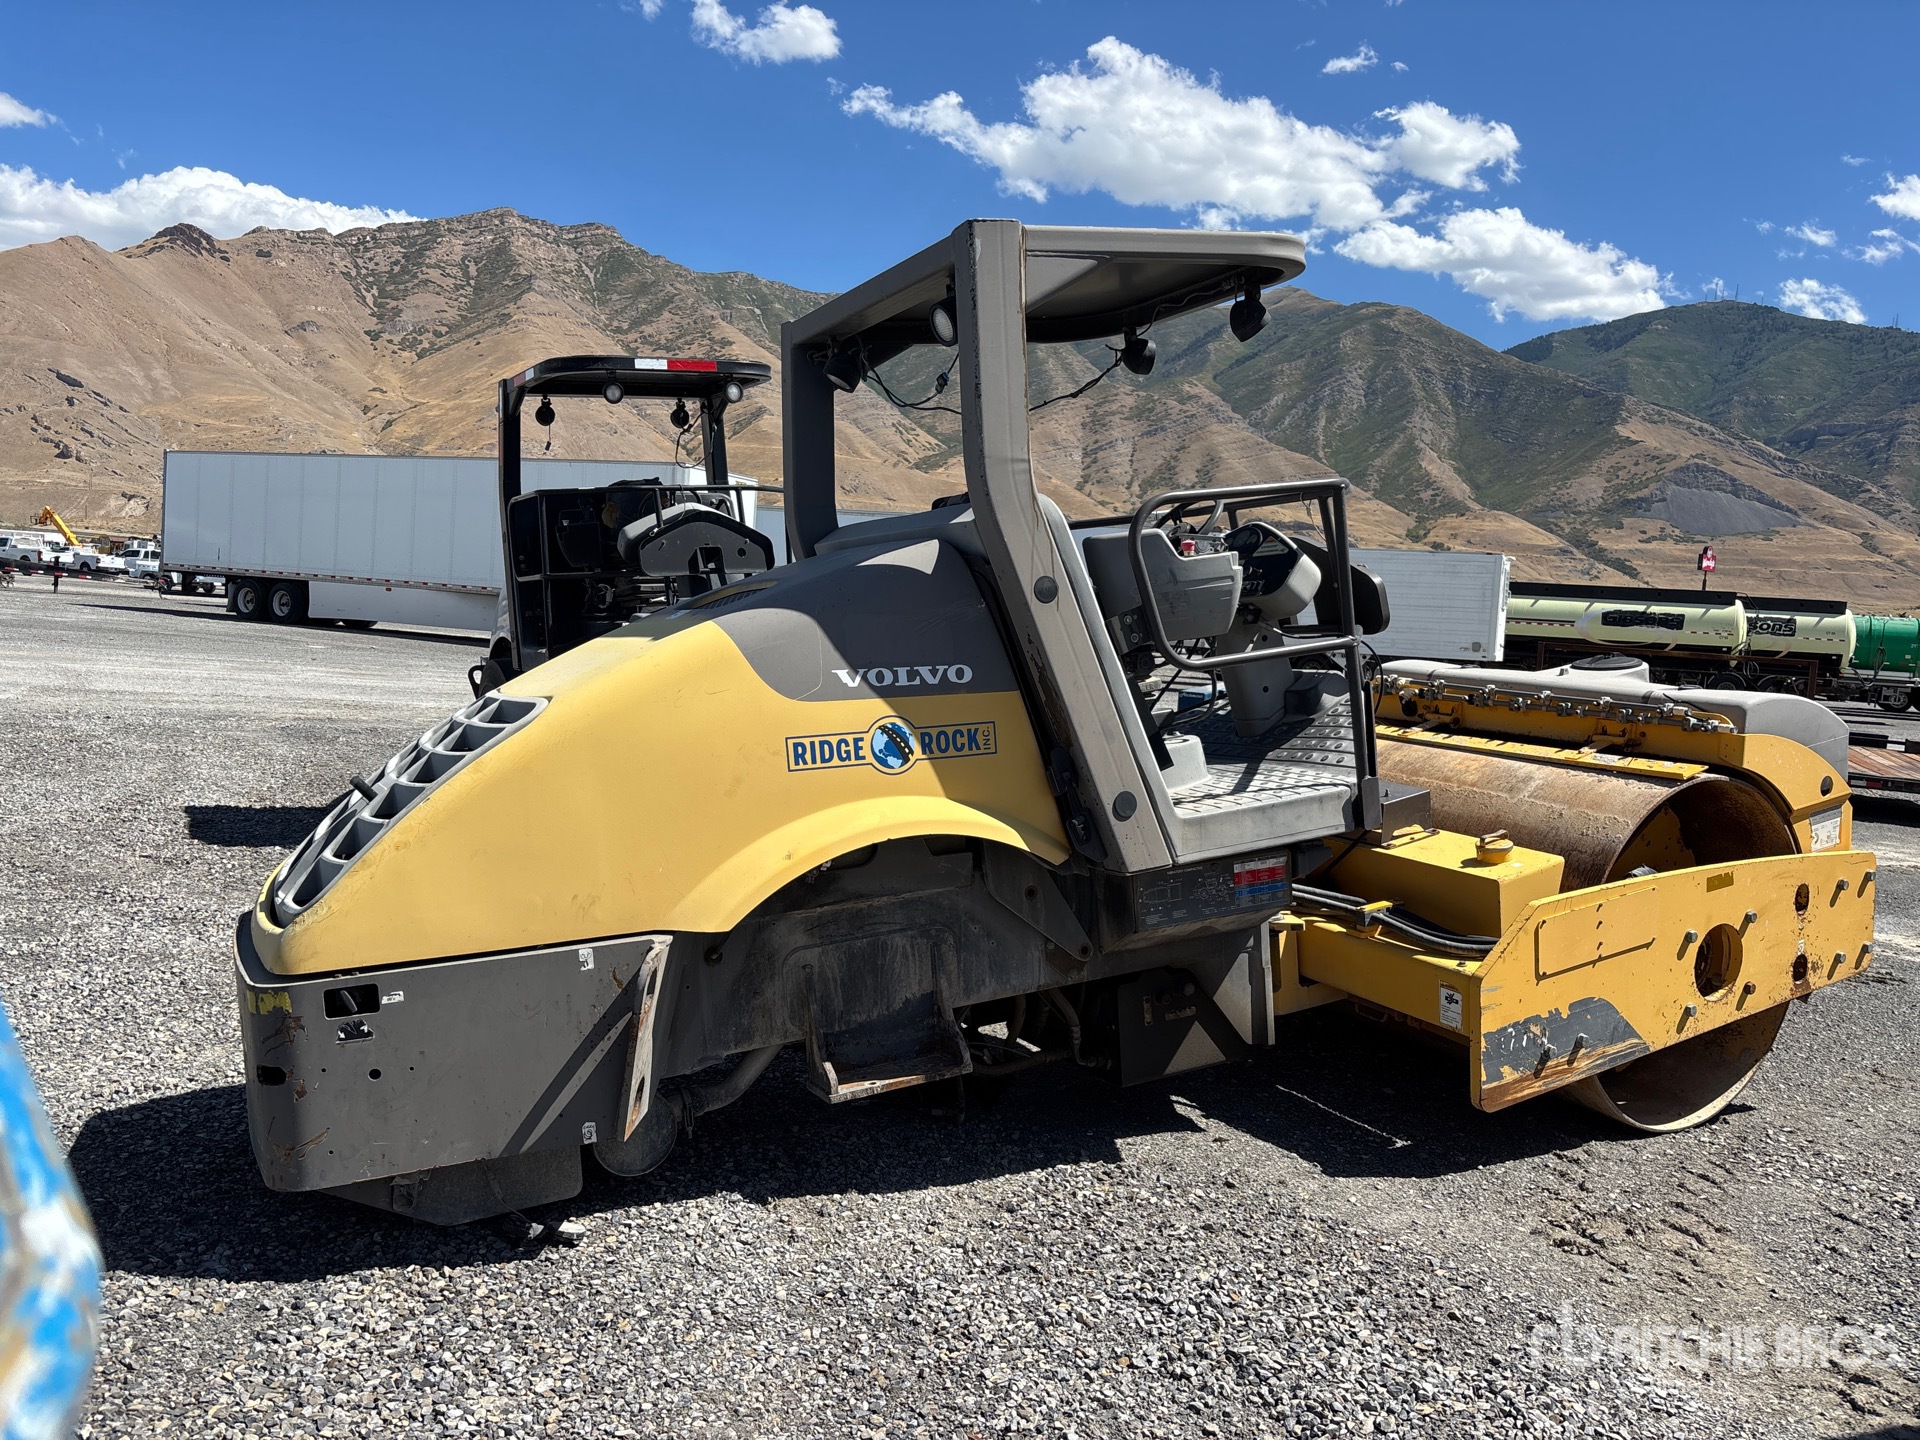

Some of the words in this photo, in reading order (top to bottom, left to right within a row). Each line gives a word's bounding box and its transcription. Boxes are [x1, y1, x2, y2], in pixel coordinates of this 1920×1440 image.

[832, 664, 973, 687] VOLVO
[792, 736, 866, 766] RIDGE
[920, 727, 981, 755] ROCK
[982, 726, 991, 750] INC.
